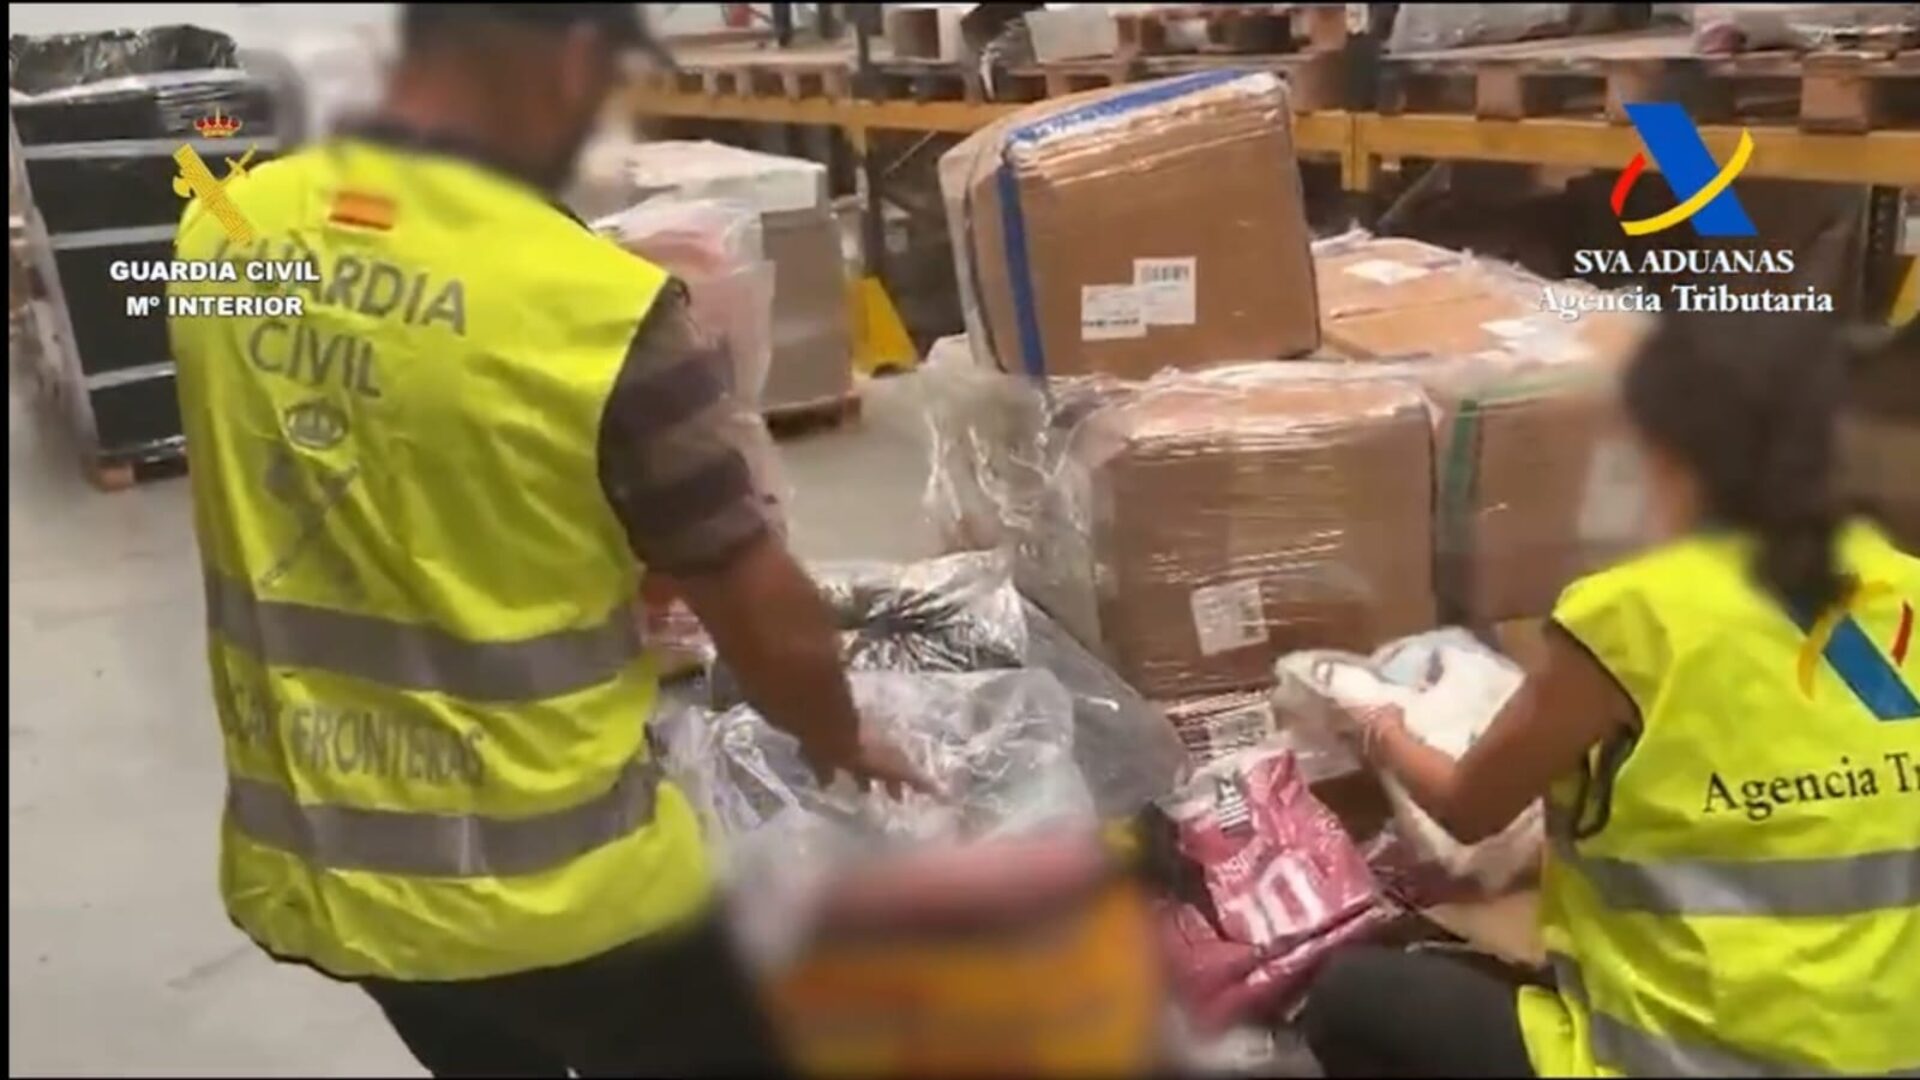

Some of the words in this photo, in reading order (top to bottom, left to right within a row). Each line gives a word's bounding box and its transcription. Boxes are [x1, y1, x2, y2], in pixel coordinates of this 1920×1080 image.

[249, 320, 382, 399] CIVIL
[290, 703, 486, 787] FRONTERAS
[1702, 756, 1879, 822] Agencia
[1220, 850, 1325, 946] 10
